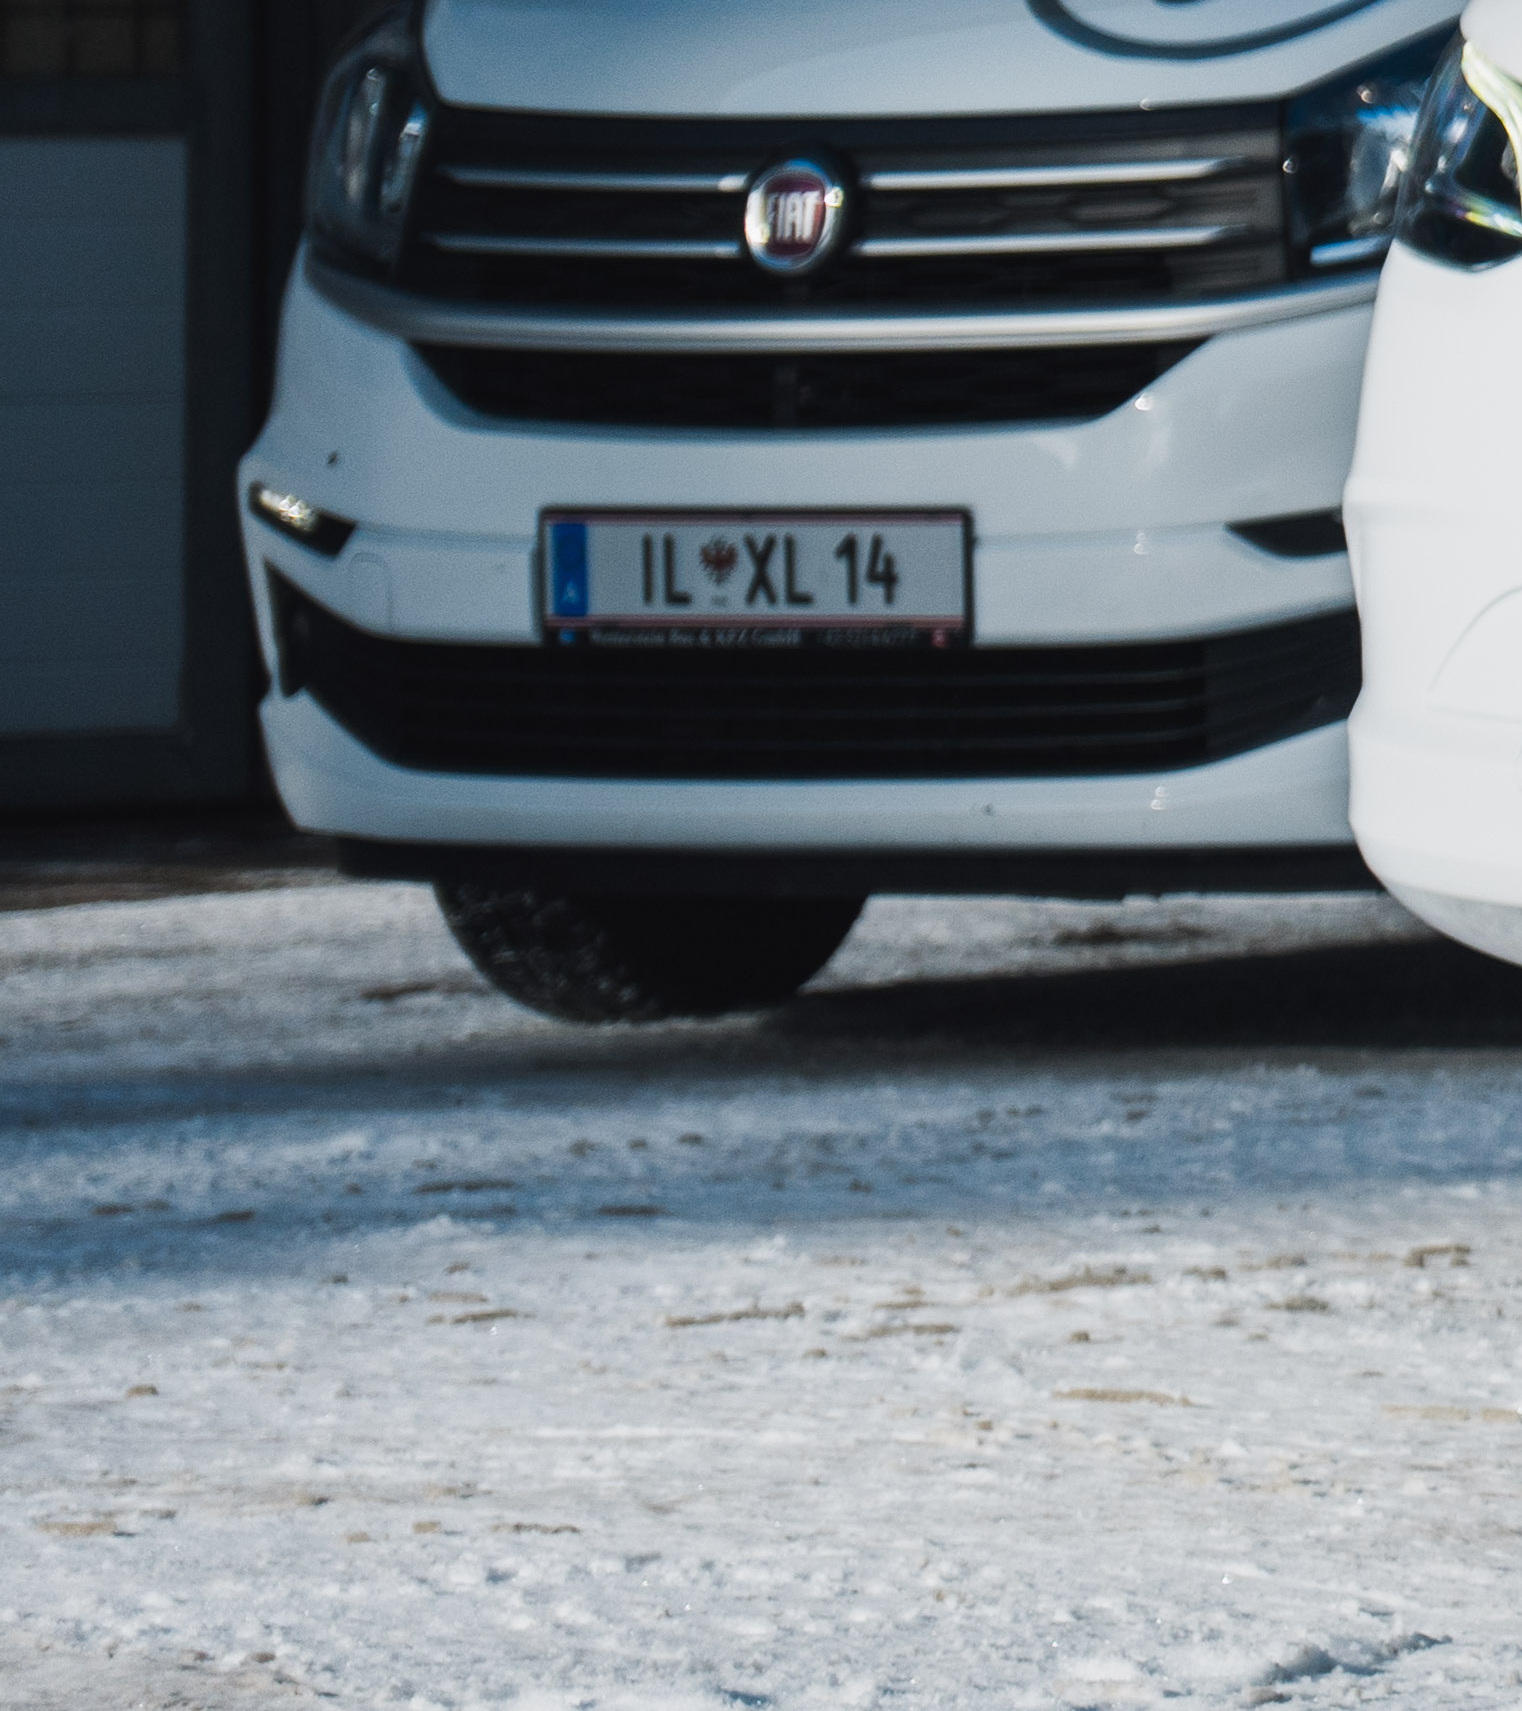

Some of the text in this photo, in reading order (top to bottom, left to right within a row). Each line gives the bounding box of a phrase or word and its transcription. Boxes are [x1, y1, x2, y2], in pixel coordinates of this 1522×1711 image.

[767, 192, 821, 242] FIAT
[641, 532, 899, 607] IL XL 14
